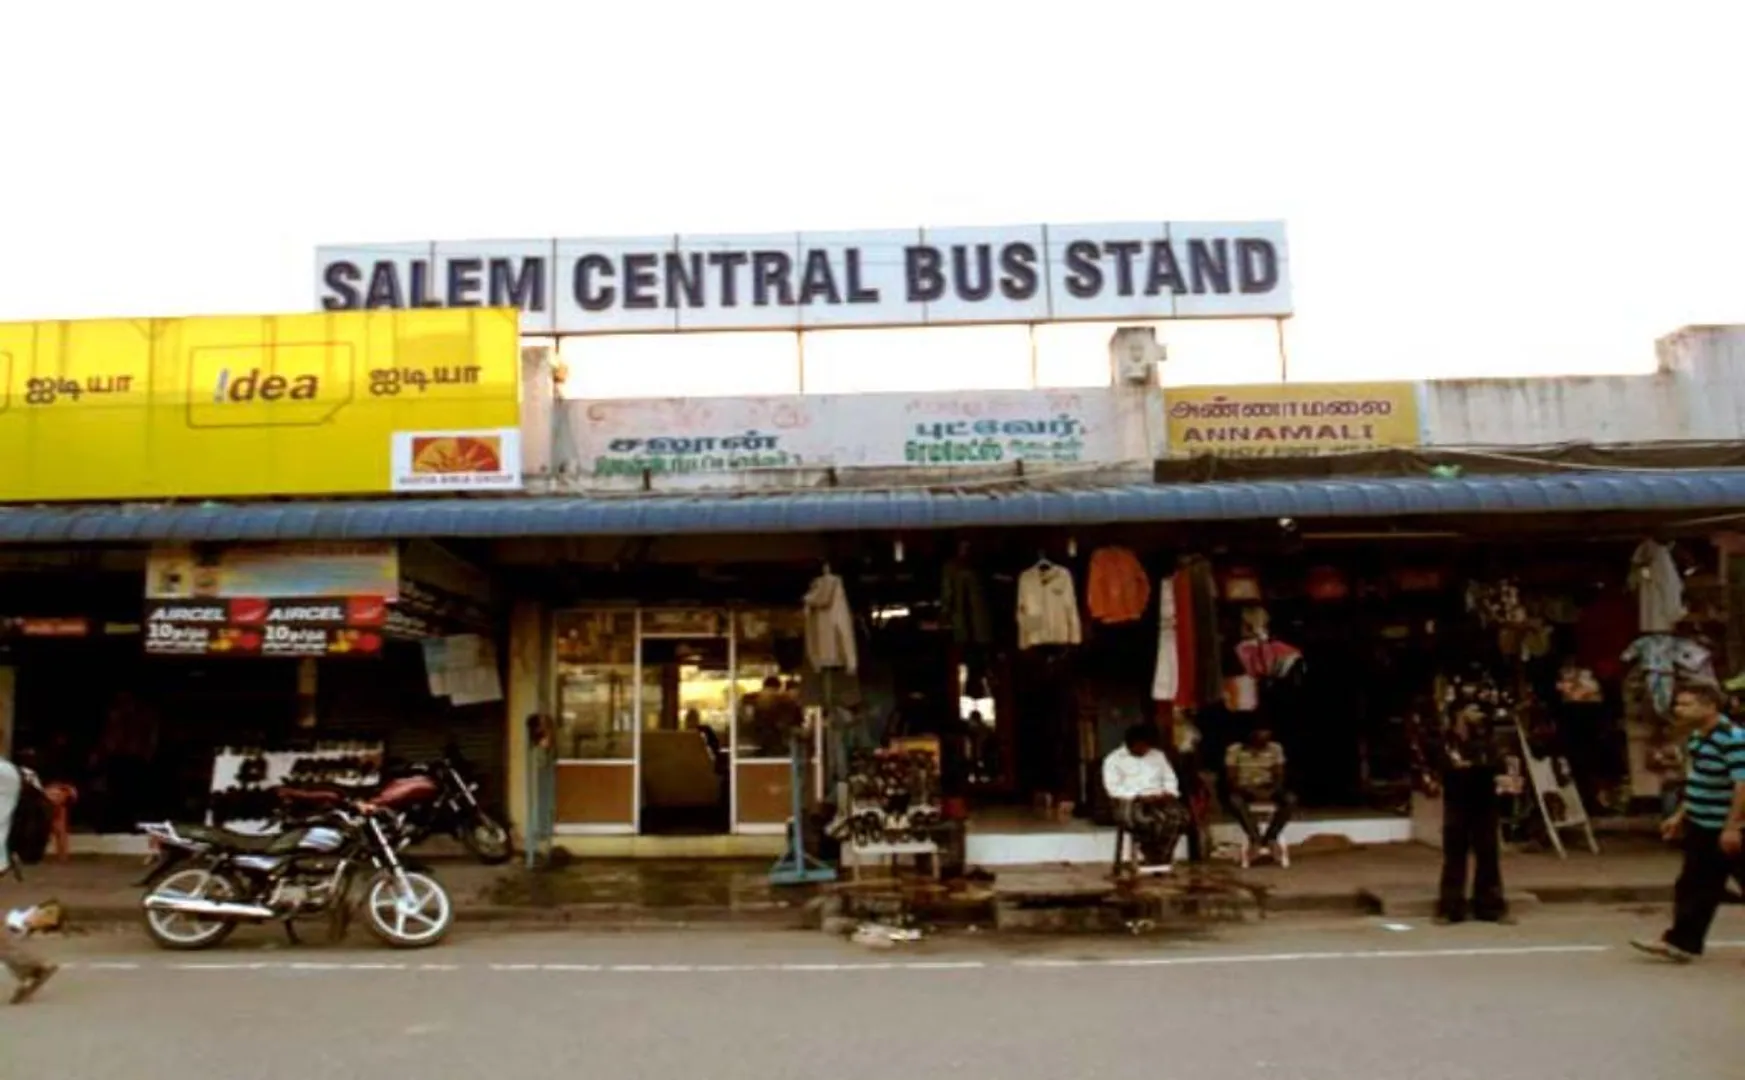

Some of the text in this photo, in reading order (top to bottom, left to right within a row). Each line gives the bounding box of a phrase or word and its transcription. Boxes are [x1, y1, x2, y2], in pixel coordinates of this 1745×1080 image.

[321, 237, 1279, 311] SALEM CENTRAL BUS STAND
[25, 374, 134, 404] ஐடியா
[368, 365, 482, 396] ஐடியா
[1183, 424, 1374, 443] ANNAMALI
[148, 606, 227, 621] AIRCEL
[266, 606, 344, 621] AIRCEL
